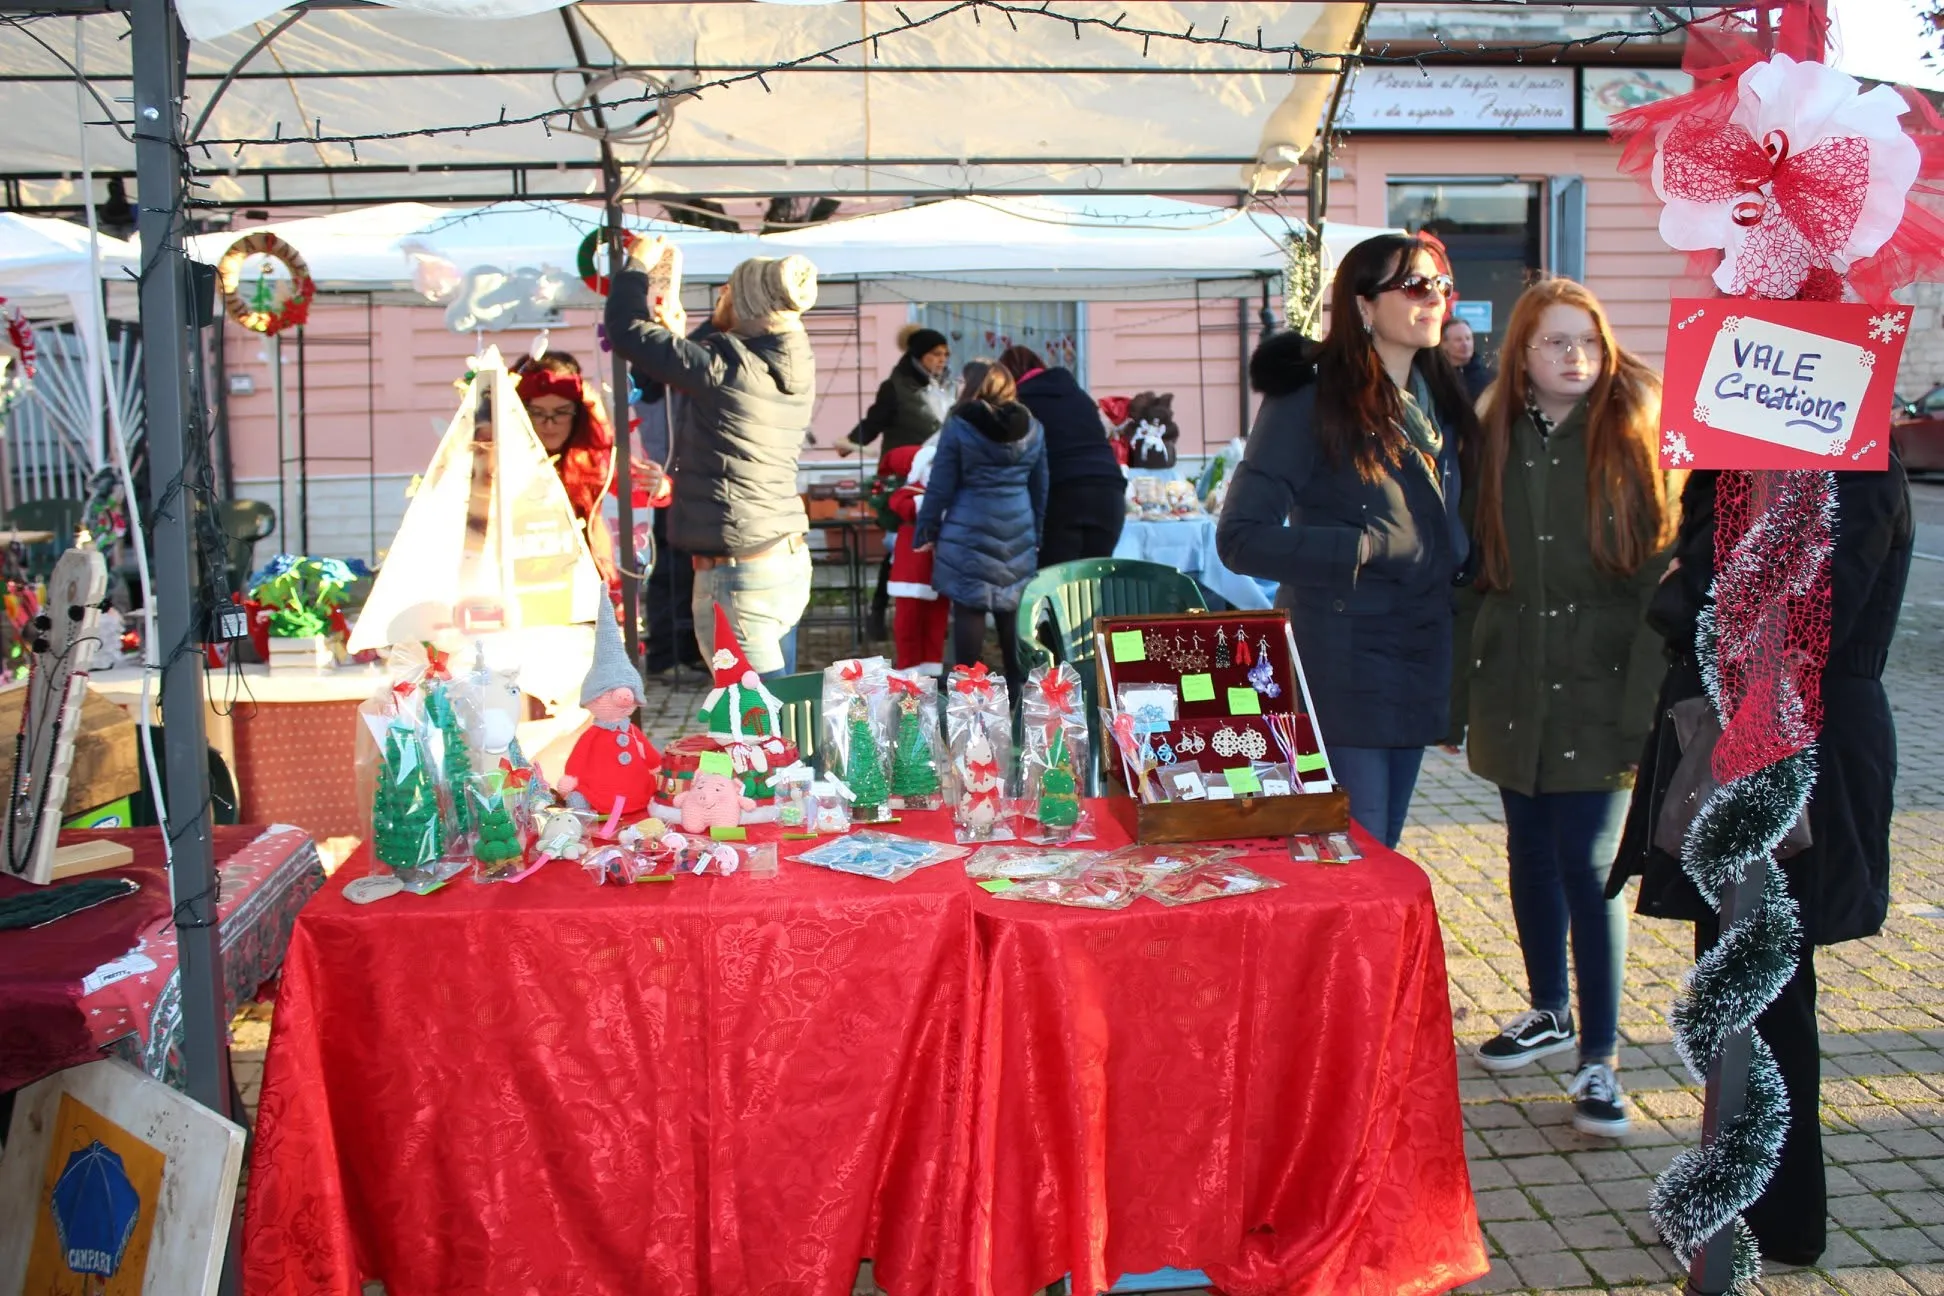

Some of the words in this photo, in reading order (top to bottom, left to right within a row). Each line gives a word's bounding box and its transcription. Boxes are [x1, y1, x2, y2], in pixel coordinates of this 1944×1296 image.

[1440, 73, 1460, 88] al
[1508, 73, 1527, 88] al
[1384, 102, 1402, 117] da
[1477, 92, 1564, 126] Friggitoria
[1733, 338, 1822, 383] VALE
[1714, 373, 1847, 434] Creations
[69, 1248, 112, 1274] CAMPARI
